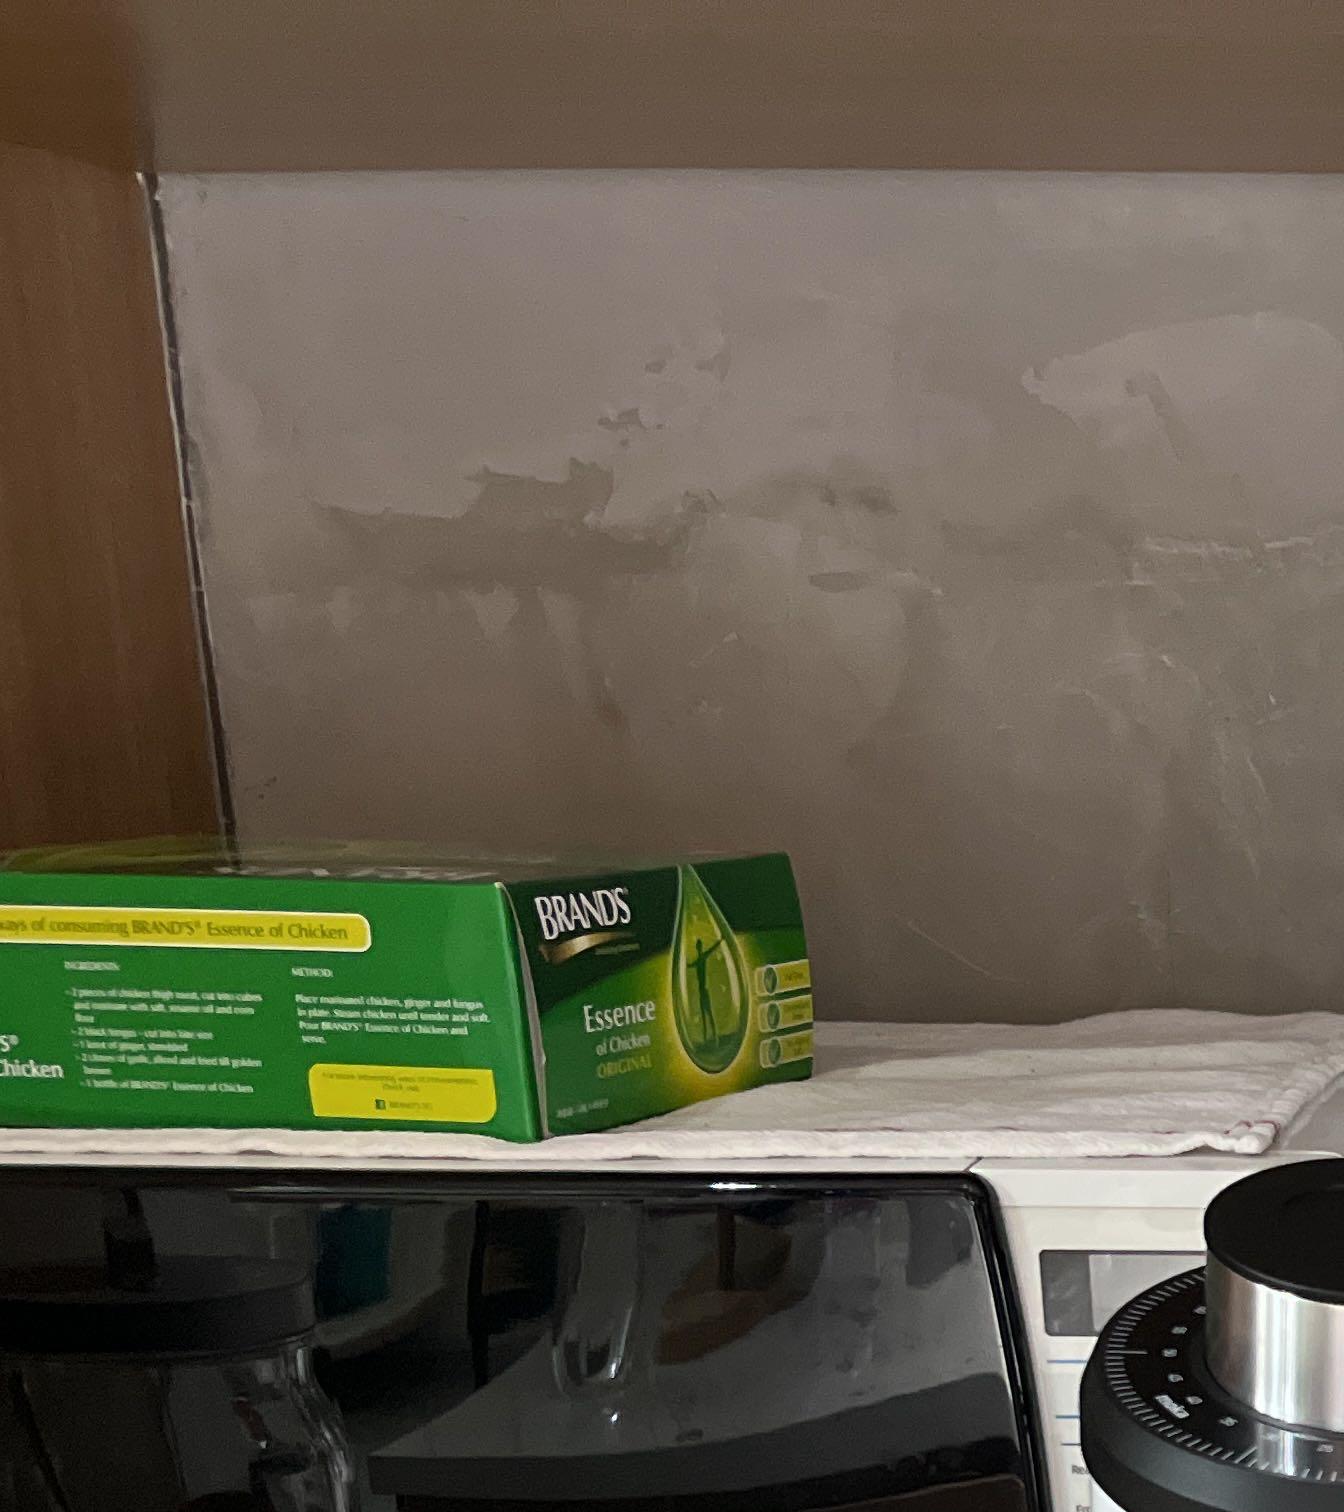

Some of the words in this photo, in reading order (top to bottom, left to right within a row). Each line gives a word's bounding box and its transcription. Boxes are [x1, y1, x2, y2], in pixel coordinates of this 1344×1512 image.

[207, 922, 264, 938] Essence
[268, 922, 285, 938] of
[288, 923, 348, 940] Chicken
[583, 1000, 656, 1033] Essence
[609, 1033, 650, 1055] Chicken
